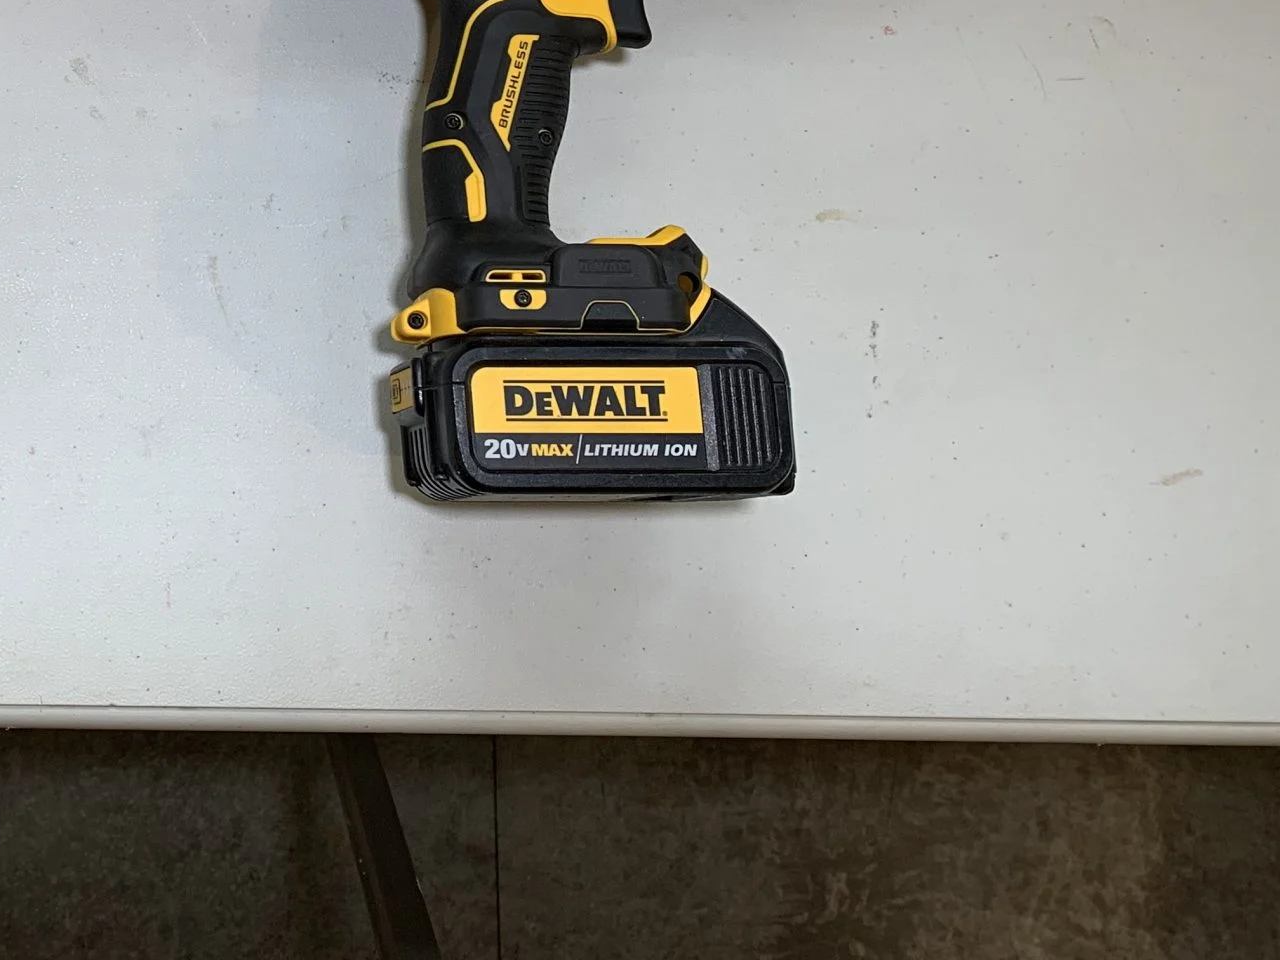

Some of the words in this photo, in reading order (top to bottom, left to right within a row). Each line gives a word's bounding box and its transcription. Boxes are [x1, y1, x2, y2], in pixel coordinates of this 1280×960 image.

[499, 41, 528, 129] BRUSHLESS
[503, 385, 668, 417] DEWALT
[584, 444, 660, 457] LITHIUM
[664, 444, 698, 457] ION
